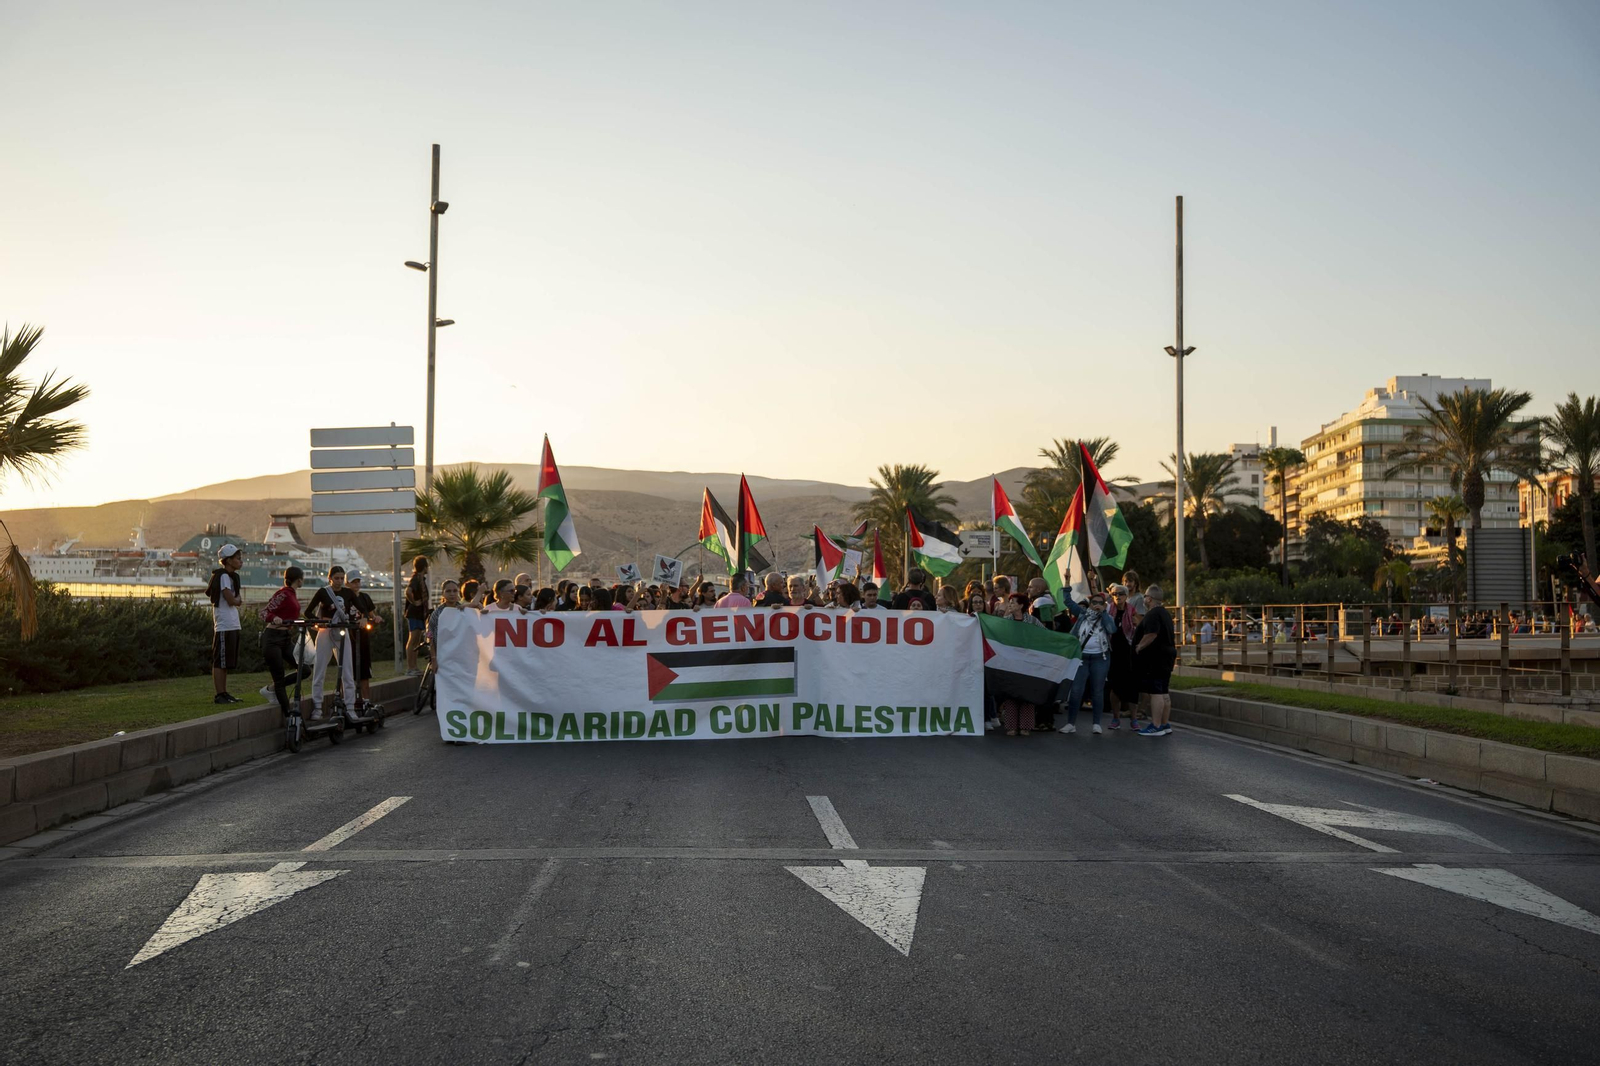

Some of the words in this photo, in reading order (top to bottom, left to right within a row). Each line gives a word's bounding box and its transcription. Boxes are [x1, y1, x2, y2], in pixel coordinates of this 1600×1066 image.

[494, 618, 565, 648] NO
[584, 618, 647, 647] AL
[665, 612, 934, 645] GENOCIDIO
[446, 708, 696, 741] SOLIDARIDAD
[709, 703, 780, 733] CON
[792, 702, 975, 734] PALESTINA
